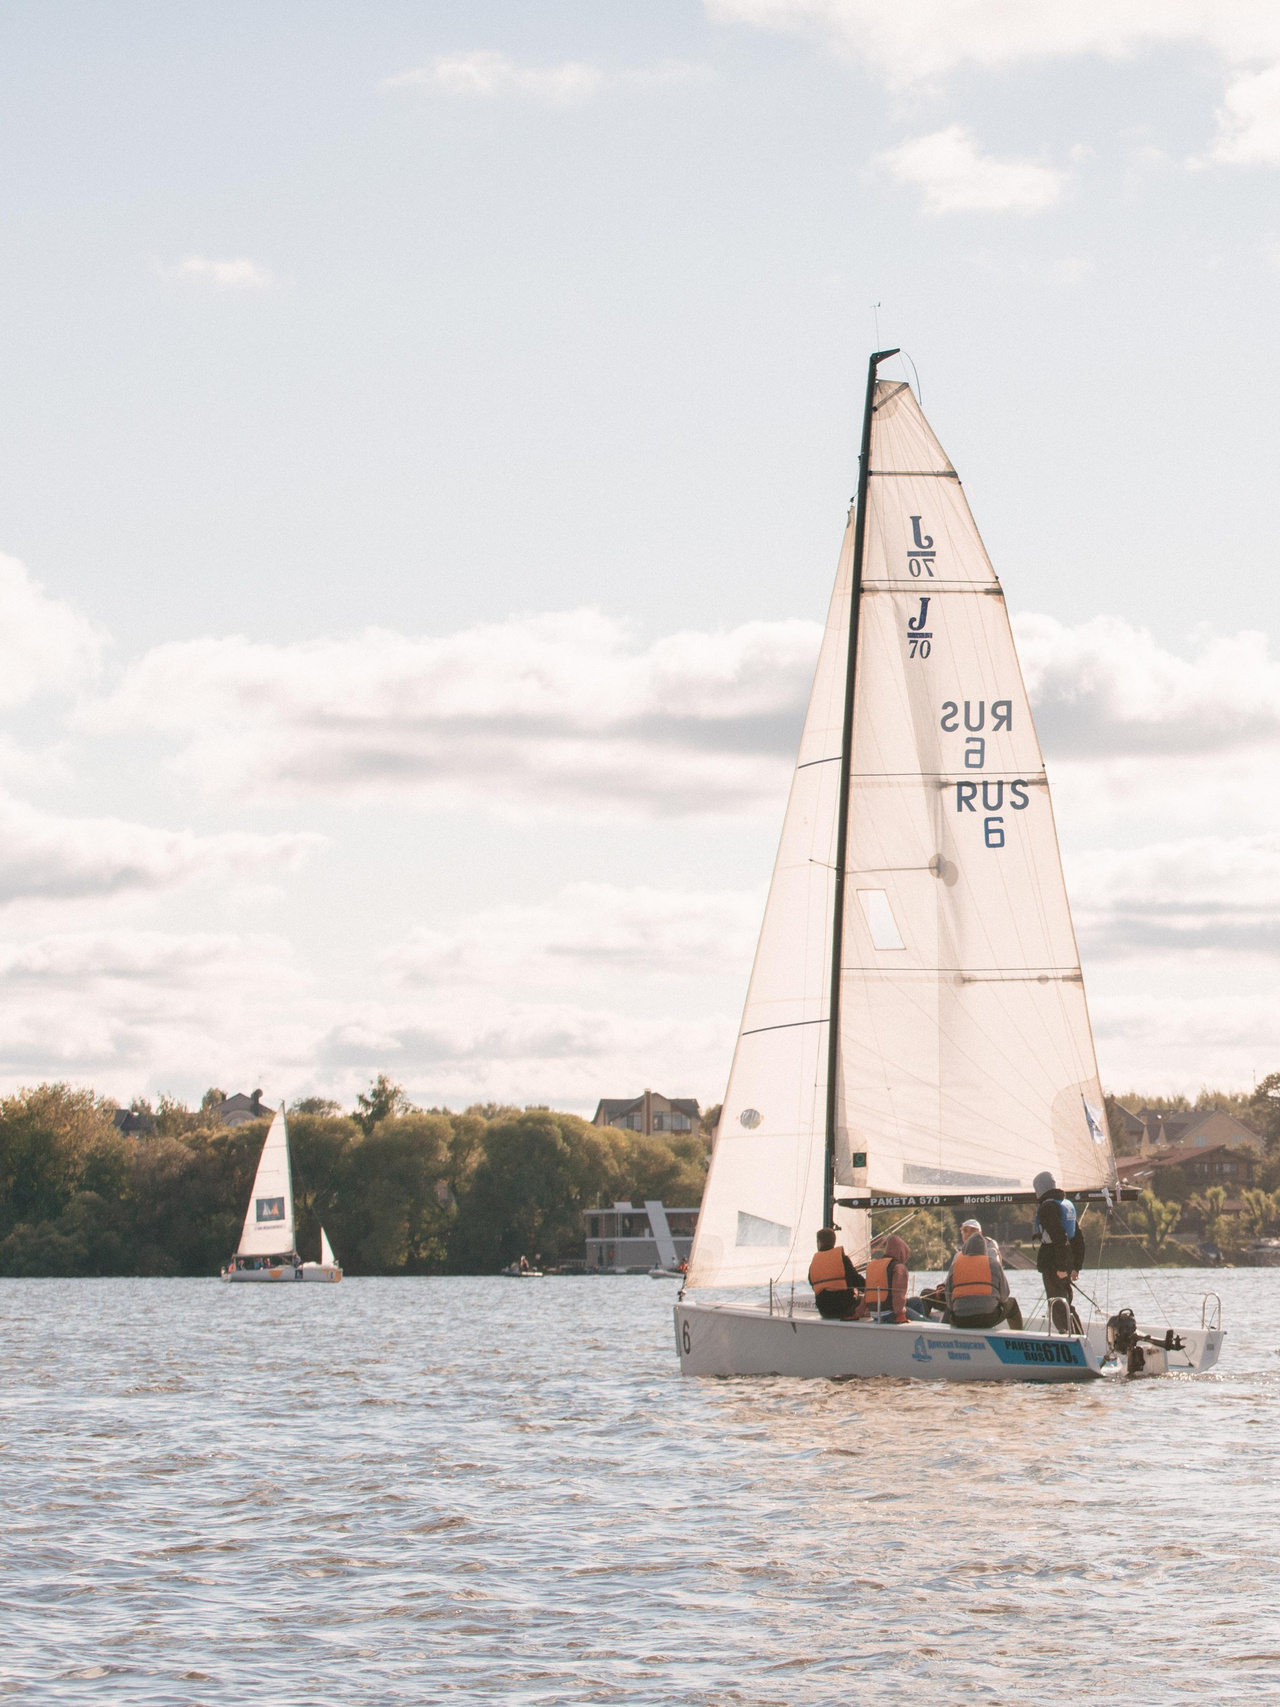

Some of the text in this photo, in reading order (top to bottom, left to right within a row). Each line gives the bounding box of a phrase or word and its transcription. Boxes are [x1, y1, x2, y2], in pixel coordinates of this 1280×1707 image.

[908, 597, 931, 631] J
[908, 640, 931, 659] 70
[956, 779, 1029, 812] RUS
[984, 816, 1005, 848] 6
[963, 1195, 1013, 1204] MoreSail.ru
[682, 1319, 691, 1355] 6
[1023, 1351, 1045, 1362] RUS
[1042, 1342, 1073, 1364] 670
